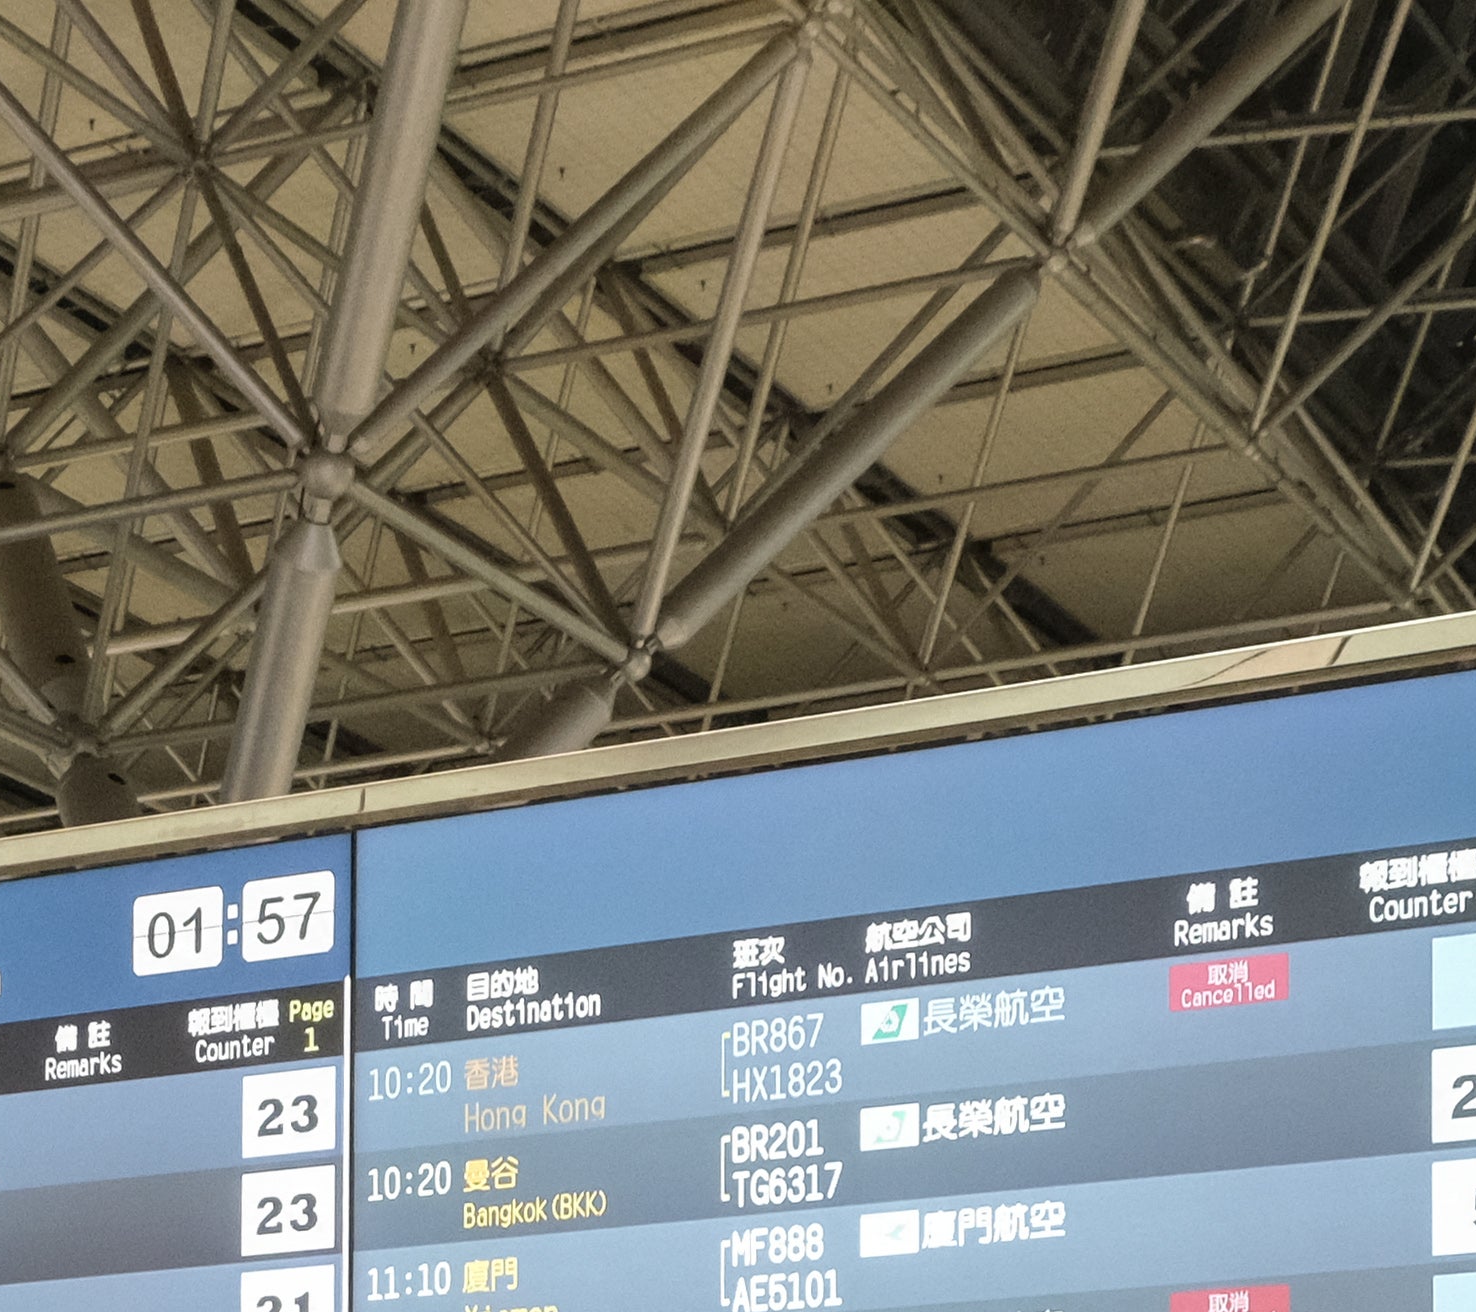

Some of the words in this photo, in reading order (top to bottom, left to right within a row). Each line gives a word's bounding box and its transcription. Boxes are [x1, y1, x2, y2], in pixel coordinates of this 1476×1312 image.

[1369, 889, 1473, 922] Counter
[1174, 912, 1274, 946] Remarks
[466, 965, 539, 1002] 目的地
[732, 966, 806, 999] Flight
[818, 962, 853, 989] No.
[865, 951, 971, 983] Airlines
[289, 999, 335, 1023] Page
[466, 991, 601, 1031] Destination
[195, 1034, 275, 1063] Counter
[304, 1026, 319, 1052] 1
[45, 1051, 122, 1081] Remarks
[368, 1060, 452, 1101] 10:20
[464, 1054, 519, 1091] 香港
